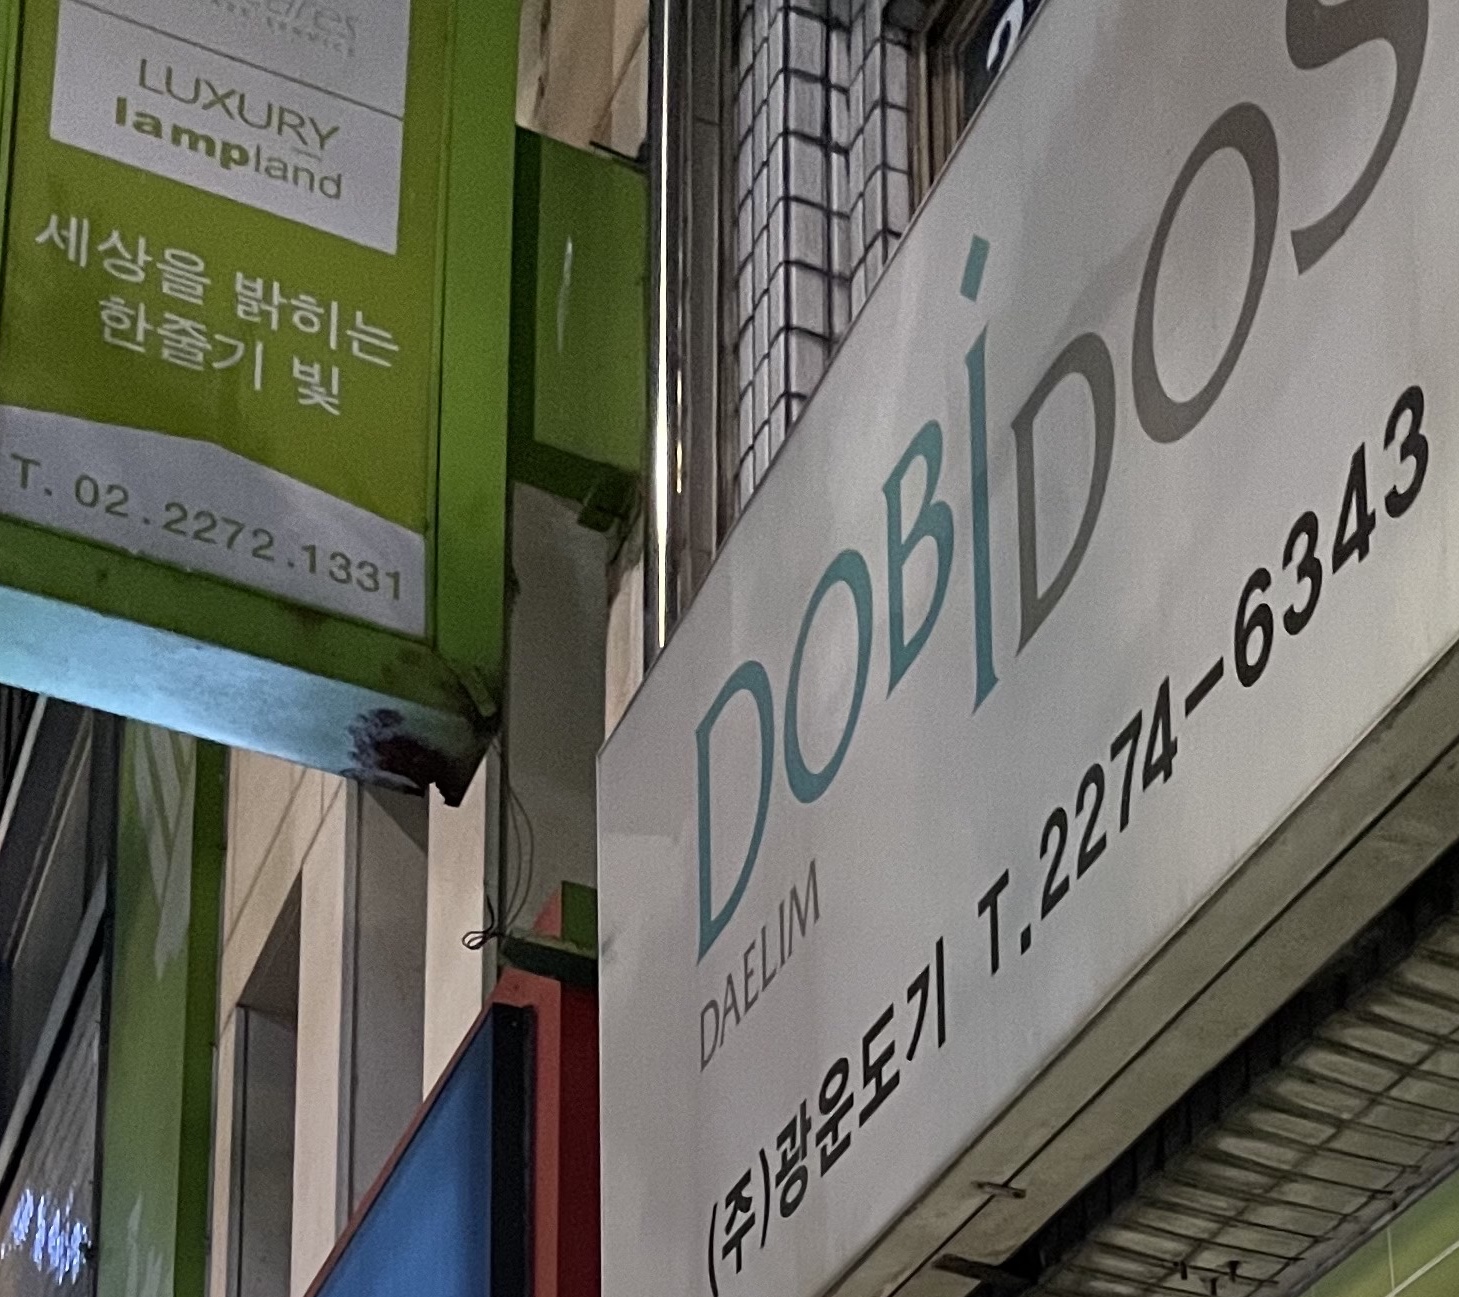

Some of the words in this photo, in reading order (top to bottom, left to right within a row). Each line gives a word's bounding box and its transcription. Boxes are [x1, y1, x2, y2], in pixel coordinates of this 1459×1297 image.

[115, 96, 344, 201] lampland
[136, 58, 341, 150] LUXURY
[35, 211, 212, 306] 세상을
[235, 270, 400, 369] 밝히는
[99, 294, 264, 392] 한줄기
[292, 356, 342, 417] 빛
[74, 472, 402, 601] 02.2272.1331
[976, 384, 1431, 977] T.2274-6343
[700, 857, 822, 1073] DAELIM
